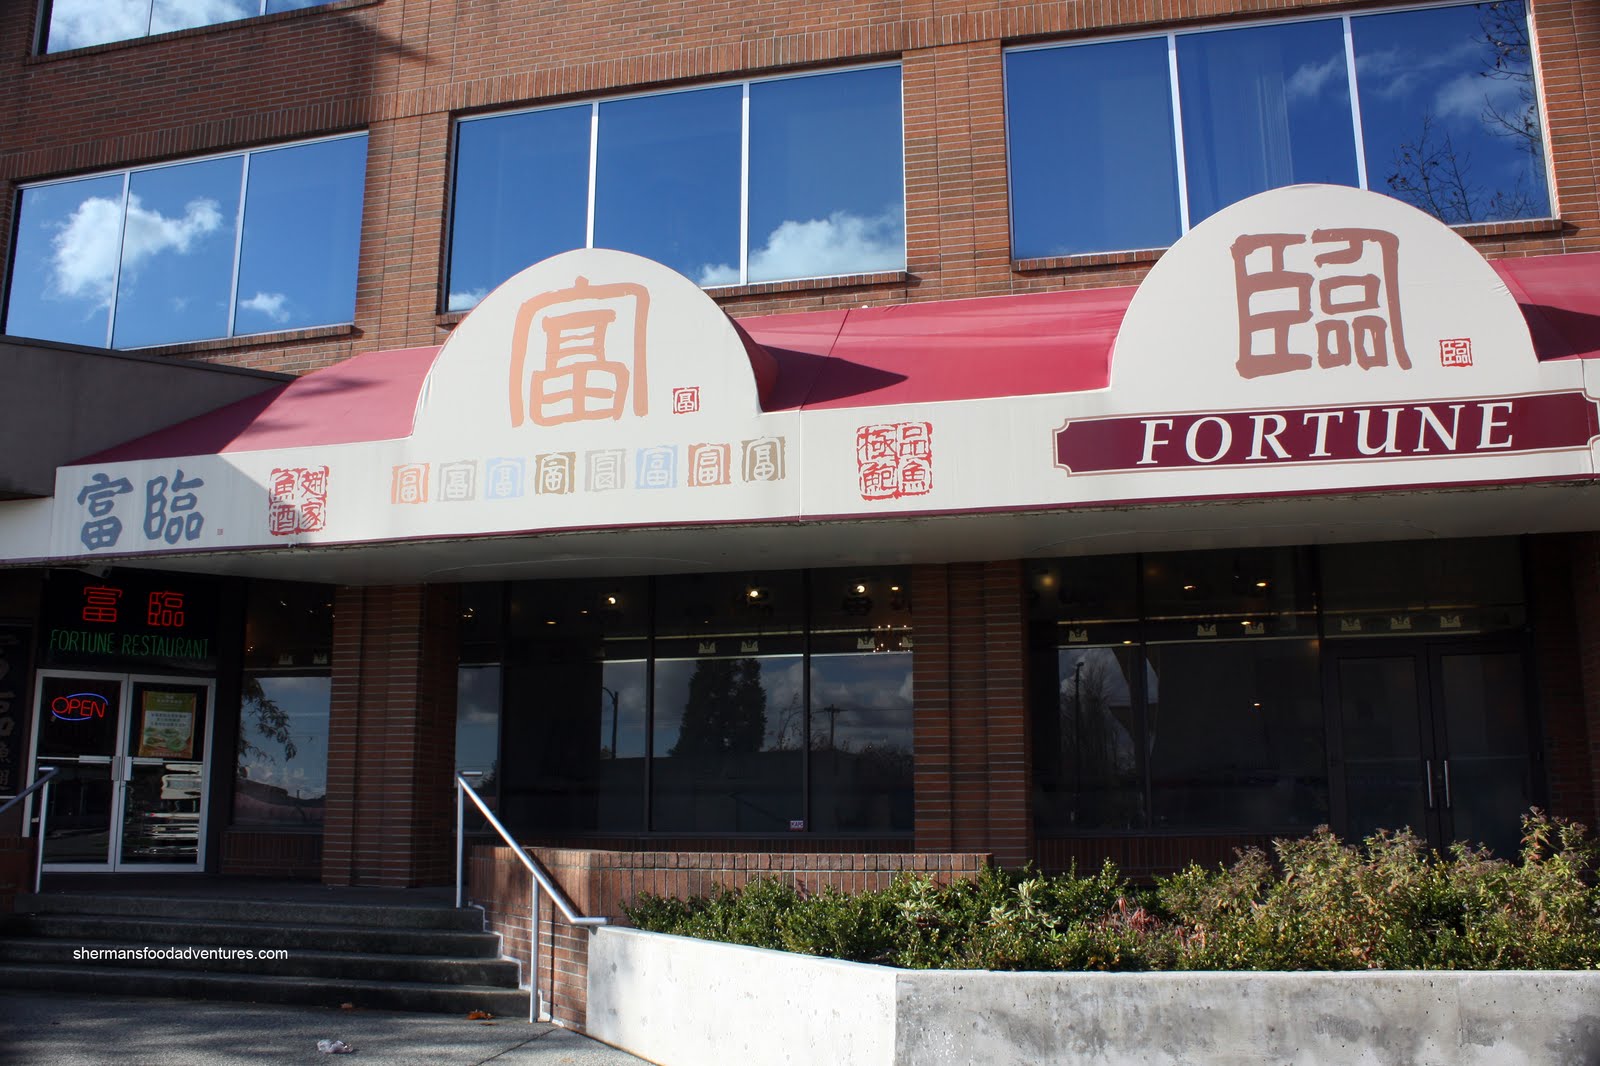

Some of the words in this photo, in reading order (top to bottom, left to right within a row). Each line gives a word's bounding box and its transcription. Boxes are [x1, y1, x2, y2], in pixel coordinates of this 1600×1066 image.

[1135, 401, 1515, 466] FORTUNE
[77, 468, 205, 551] 富臨
[50, 628, 115, 655] FORTUNE
[121, 633, 209, 660] RESTAURANT
[52, 695, 106, 719] OPEN
